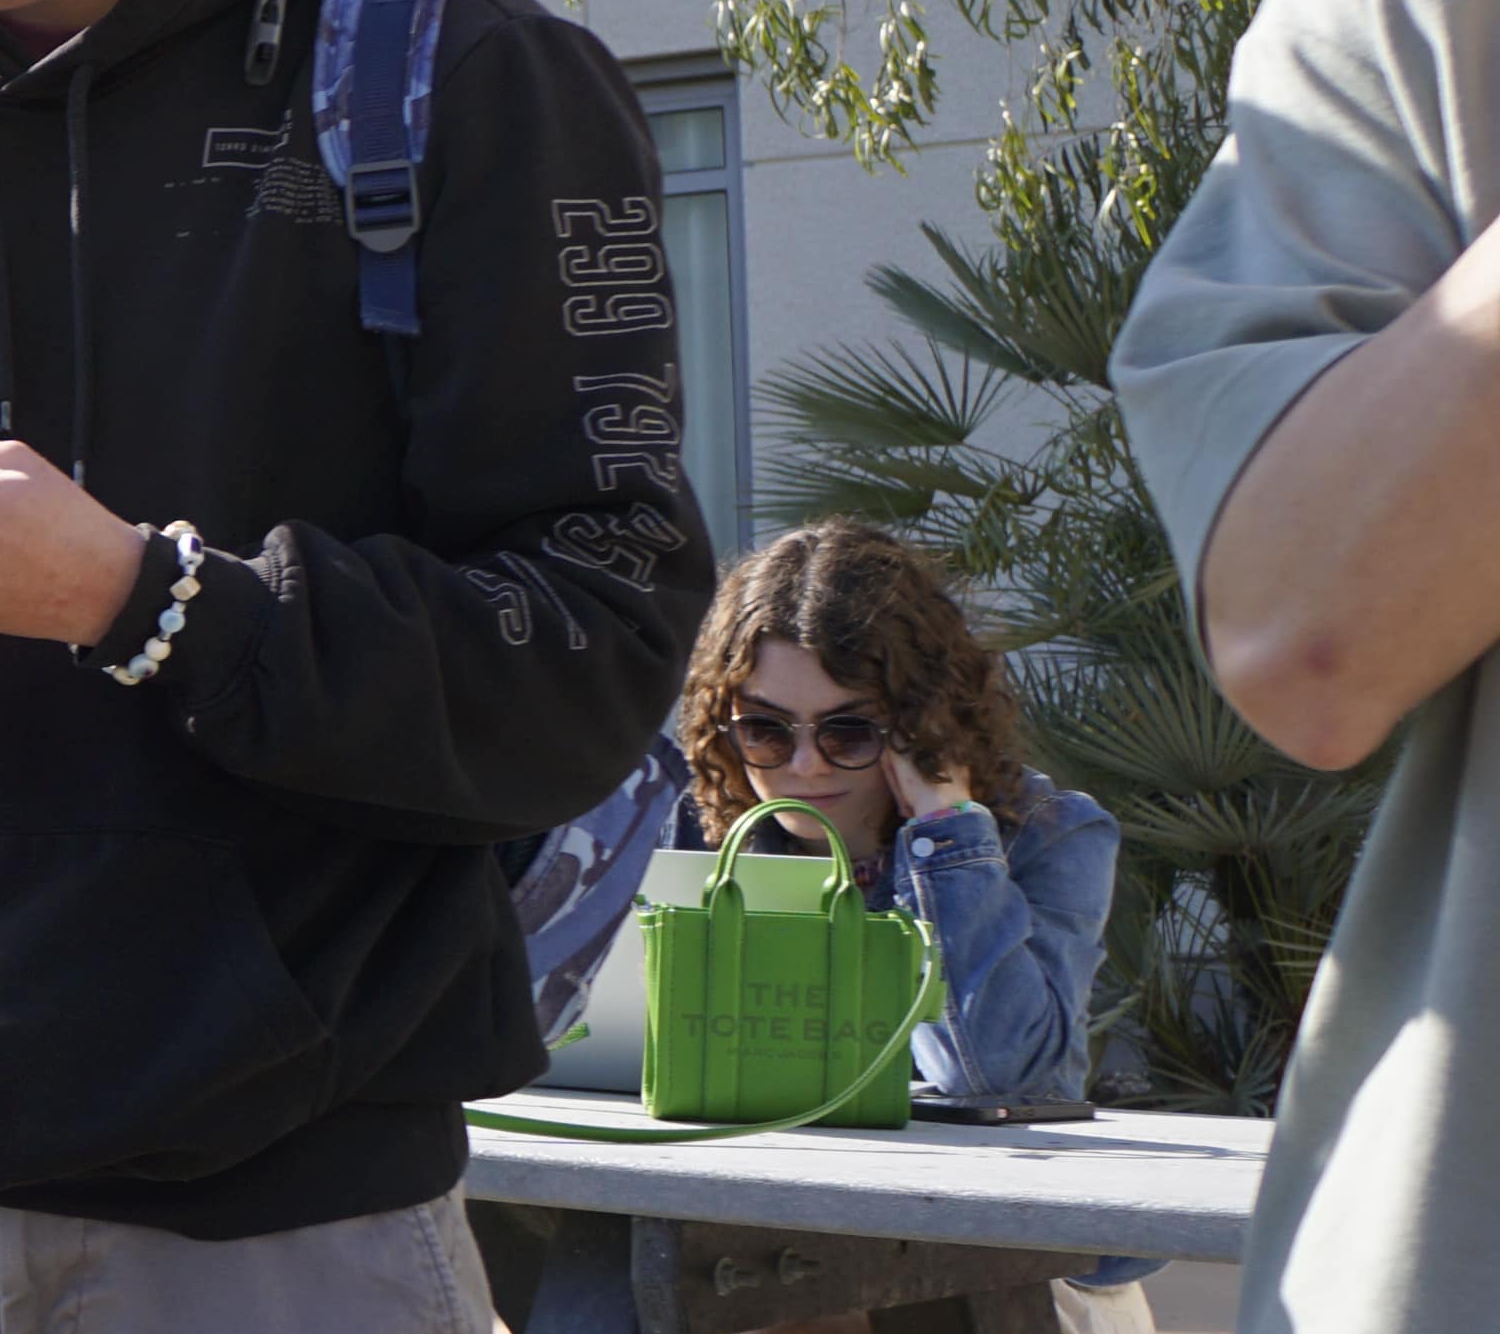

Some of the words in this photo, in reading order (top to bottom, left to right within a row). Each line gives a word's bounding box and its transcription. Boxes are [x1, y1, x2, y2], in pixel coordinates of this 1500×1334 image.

[551, 194, 675, 337] 299
[572, 363, 680, 493] 792
[540, 501, 688, 593] 45
[676, 1013, 793, 1041] TOTE
[803, 1017, 891, 1047] BAG
[748, 982, 827, 1009] THE
